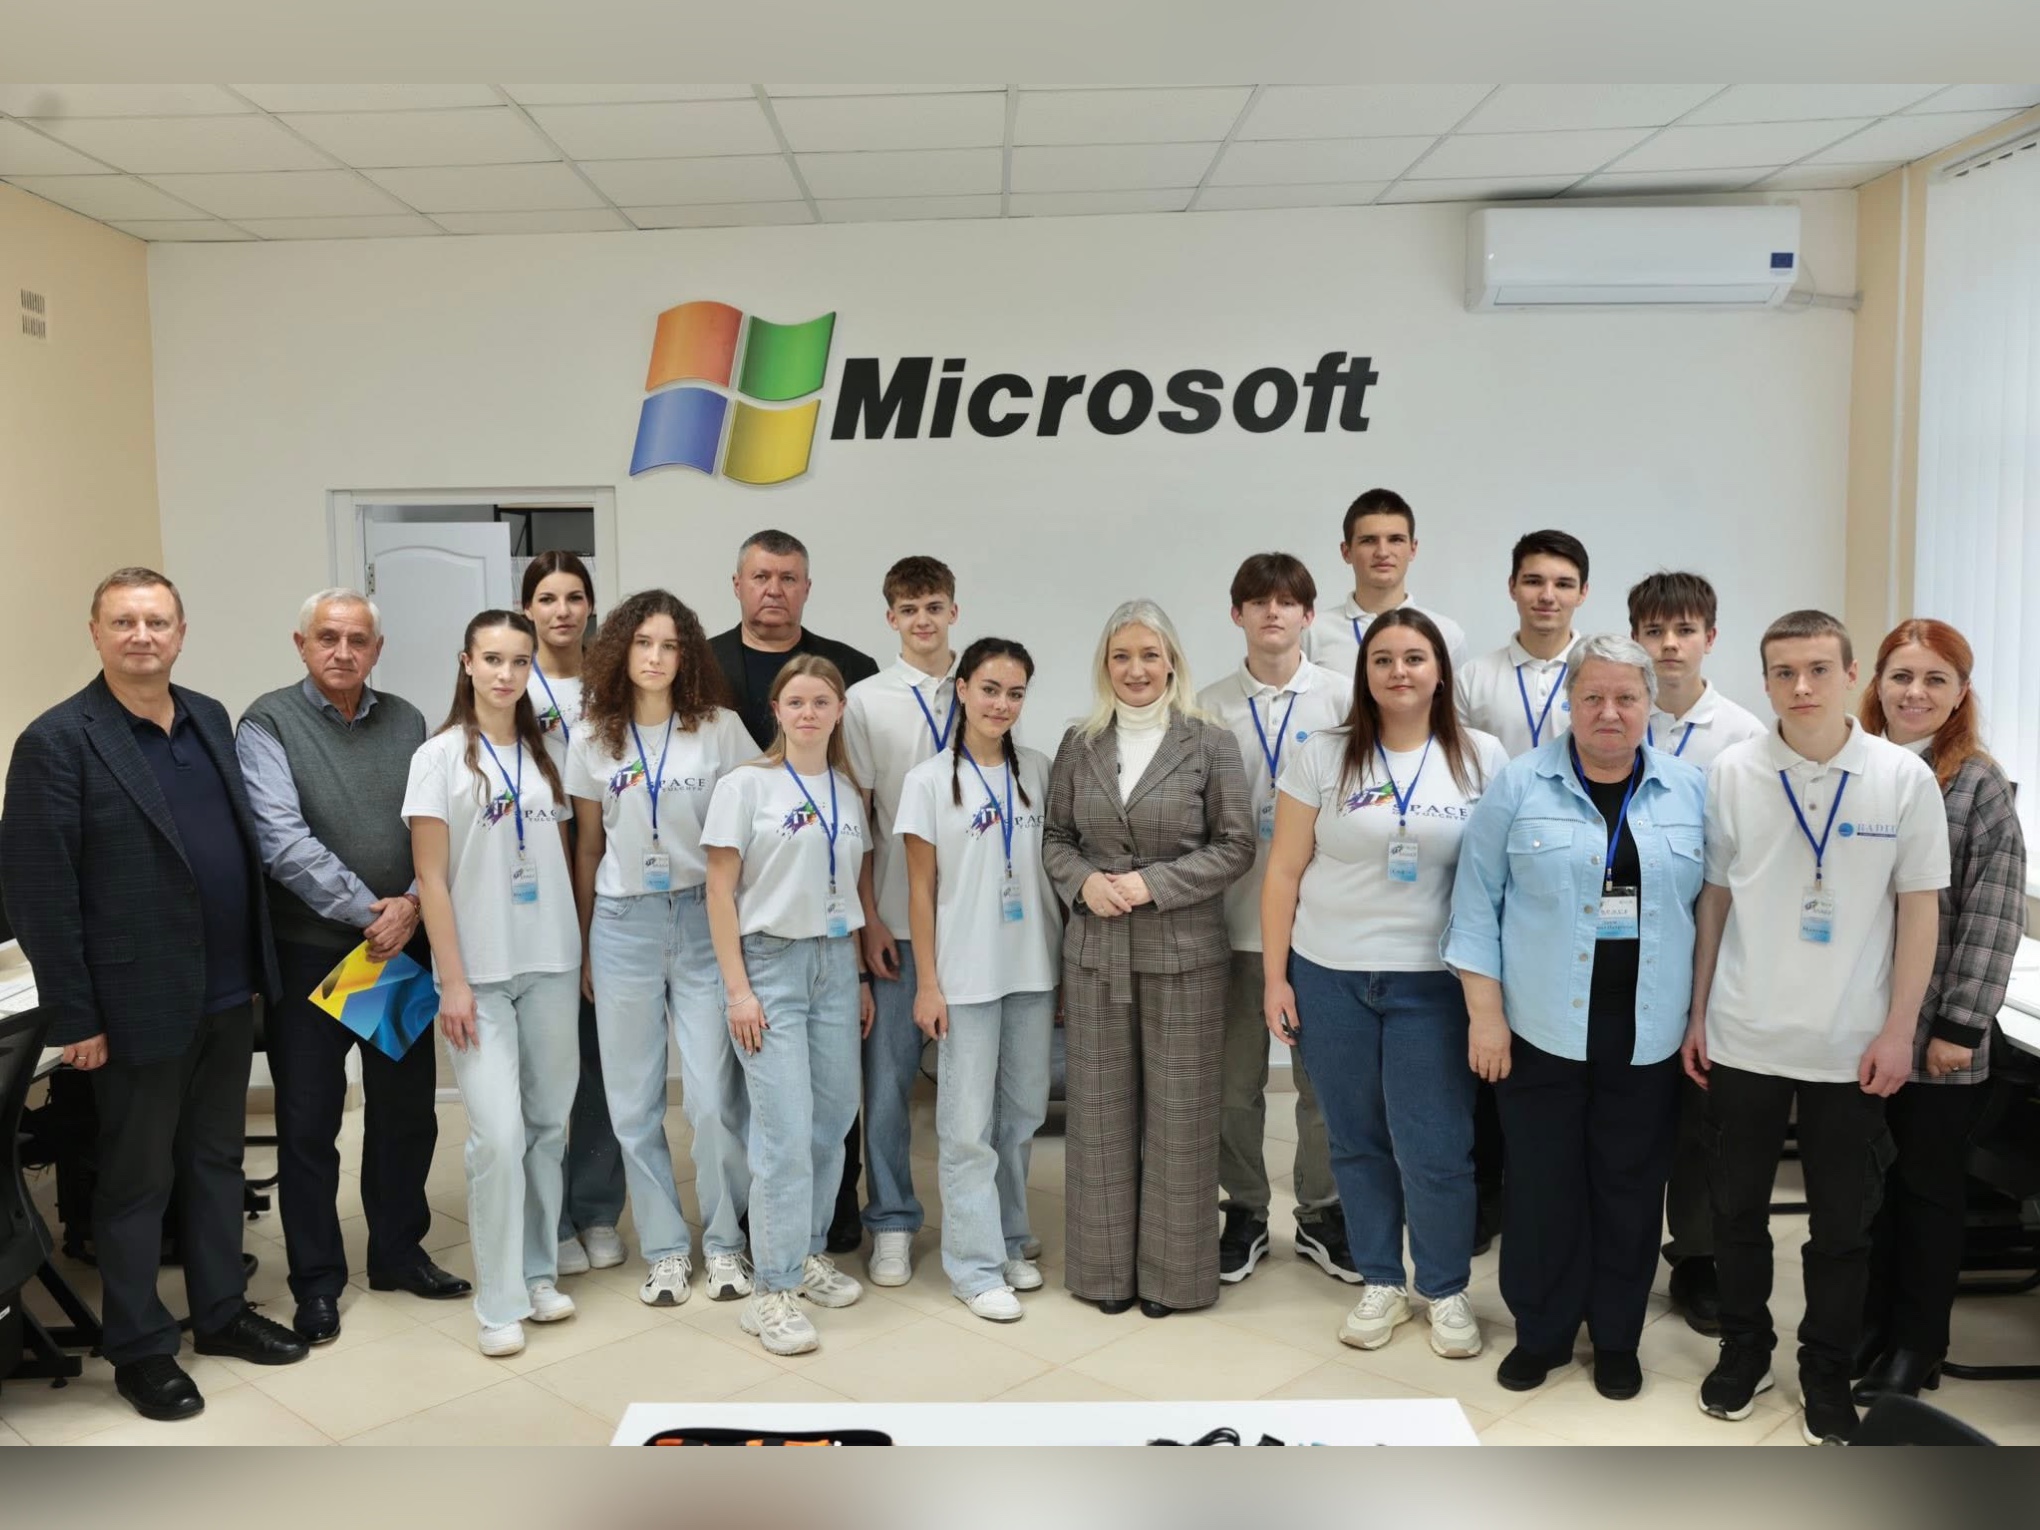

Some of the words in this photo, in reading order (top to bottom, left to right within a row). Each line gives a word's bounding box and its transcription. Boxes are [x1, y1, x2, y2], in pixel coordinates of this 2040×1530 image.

[830, 351, 1379, 440] Microsoft
[616, 770, 638, 788] IT
[493, 799, 511, 815] IT
[981, 807, 997, 824] IT
[792, 810, 811, 825] IT
